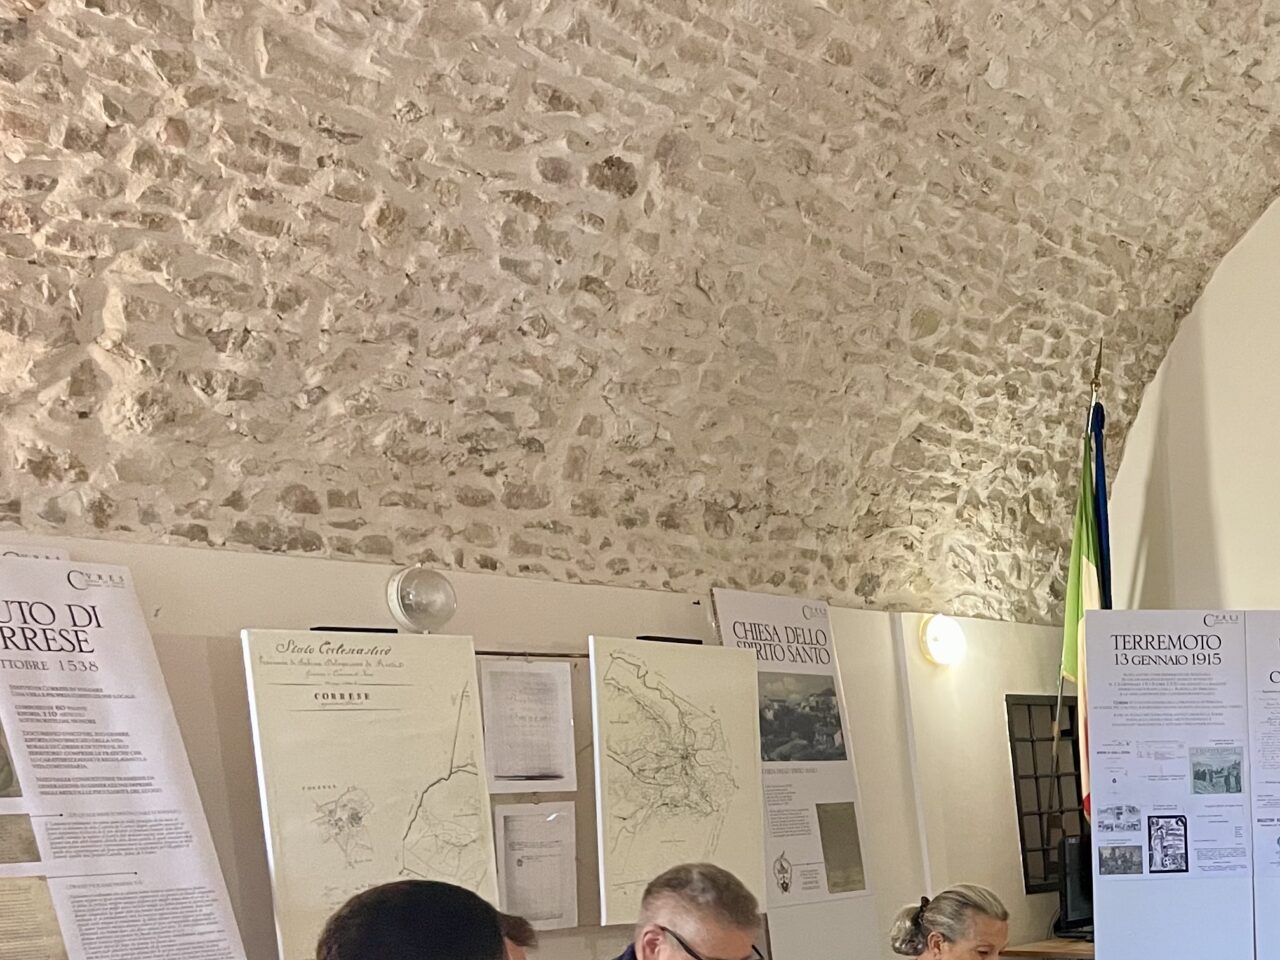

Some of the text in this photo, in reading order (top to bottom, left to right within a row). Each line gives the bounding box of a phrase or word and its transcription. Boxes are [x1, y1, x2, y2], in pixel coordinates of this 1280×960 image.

[64, 603, 103, 628] DI
[0, 625, 95, 654] RRESE
[733, 620, 827, 647] CHIESA DELLO
[1111, 634, 1222, 650] TERREMOTO
[787, 644, 831, 665] SANTO
[1114, 653, 1222, 666] 13 GENNAIO 1915
[59, 660, 99, 673] 1538
